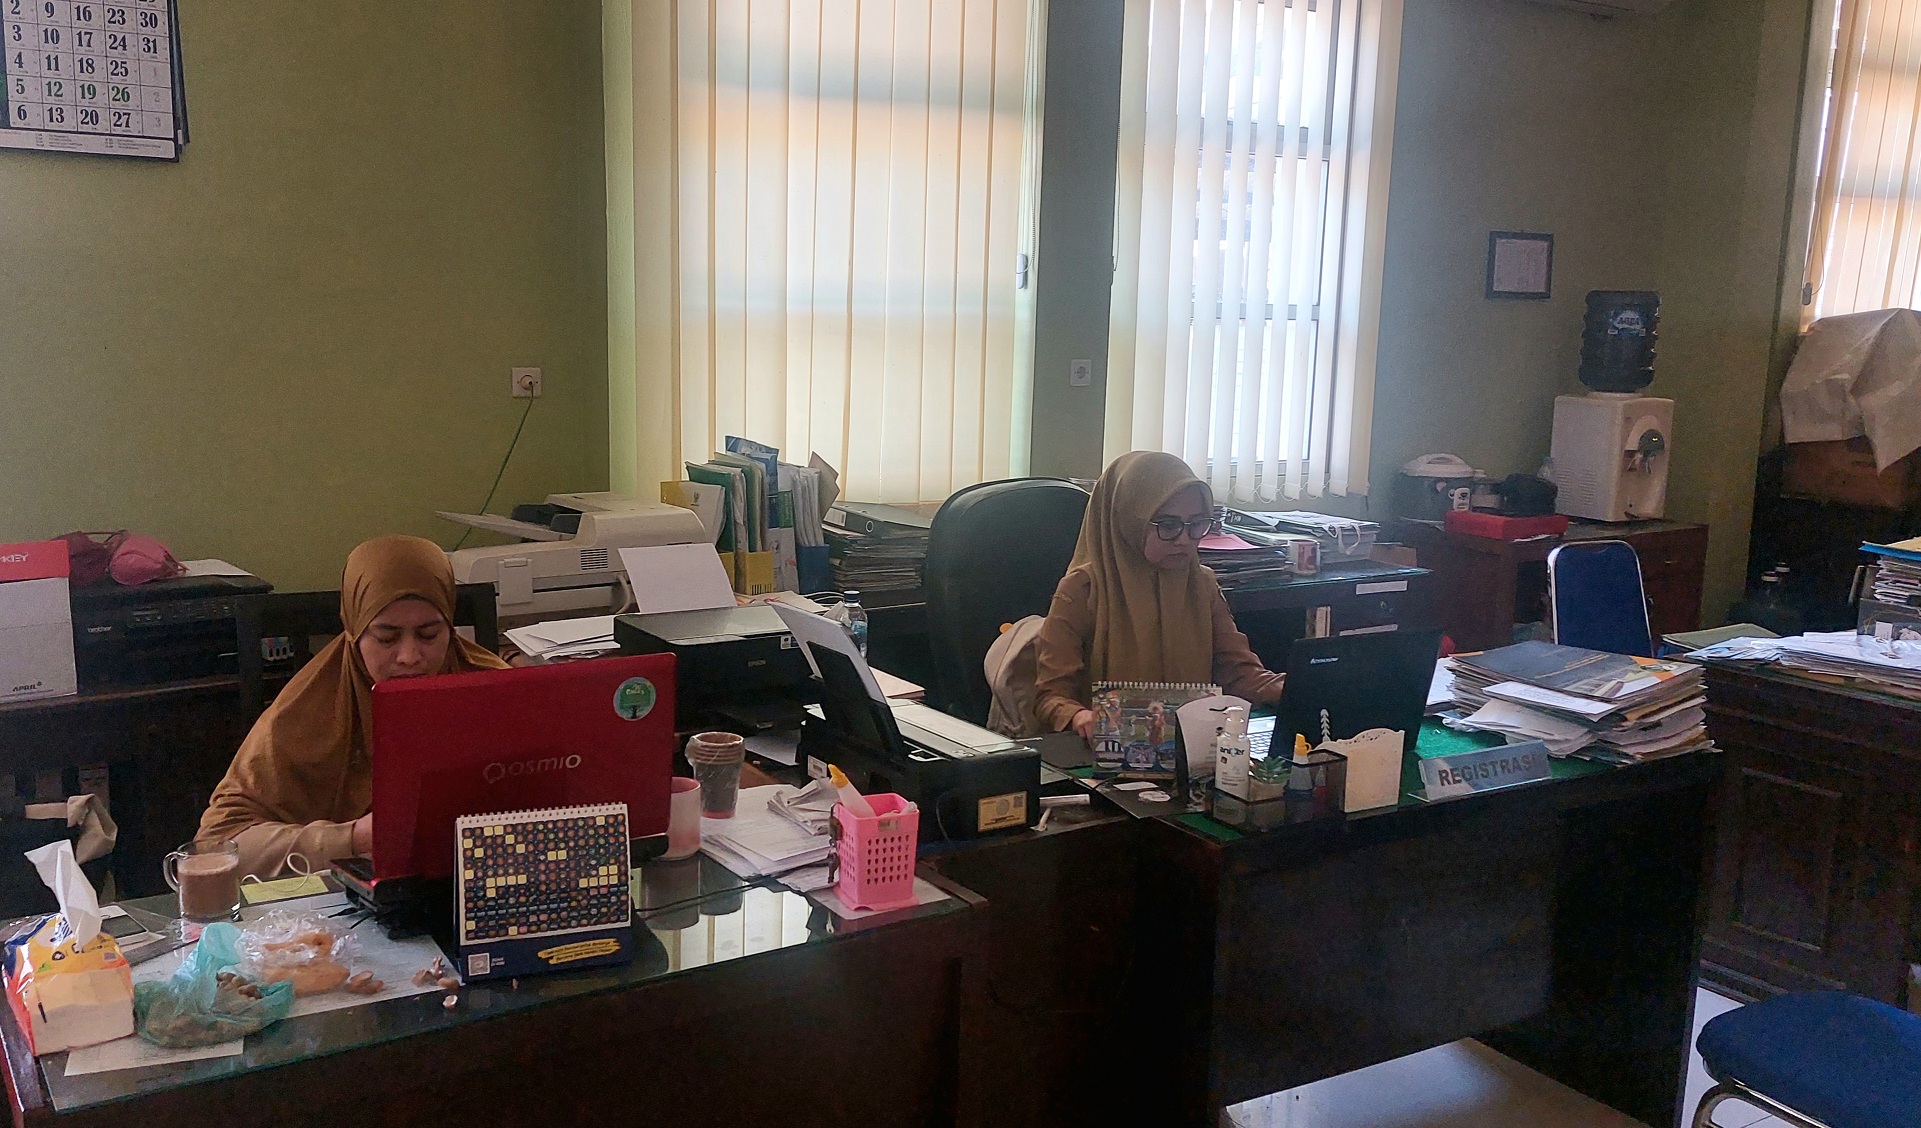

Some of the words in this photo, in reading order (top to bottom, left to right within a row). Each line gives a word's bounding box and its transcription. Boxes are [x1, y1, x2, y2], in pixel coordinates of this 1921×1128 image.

[10, 0, 20, 15] 2
[44, 2, 55, 18] 9
[75, 5, 92, 22] 16
[107, 8, 126, 25] 23
[140, 11, 158, 28] 30
[13, 24, 22, 41] 3
[43, 28, 60, 44] 10
[76, 30, 93, 47] 17
[109, 34, 127, 51] 24
[142, 37, 158, 54] 31
[14, 51, 24, 68] 4
[45, 54, 60, 71] 11
[78, 57, 95, 74] 18
[110, 60, 129, 77] 25
[16, 78, 25, 94] 5
[45, 81, 64, 97] 12
[80, 83, 97, 99] 19
[111, 86, 131, 102] 26
[17, 104, 27, 120] 6
[47, 106, 65, 123] 13
[80, 109, 99, 125] 20
[113, 111, 131, 128] 27
[1438, 753, 1537, 786] REGISTRAS
